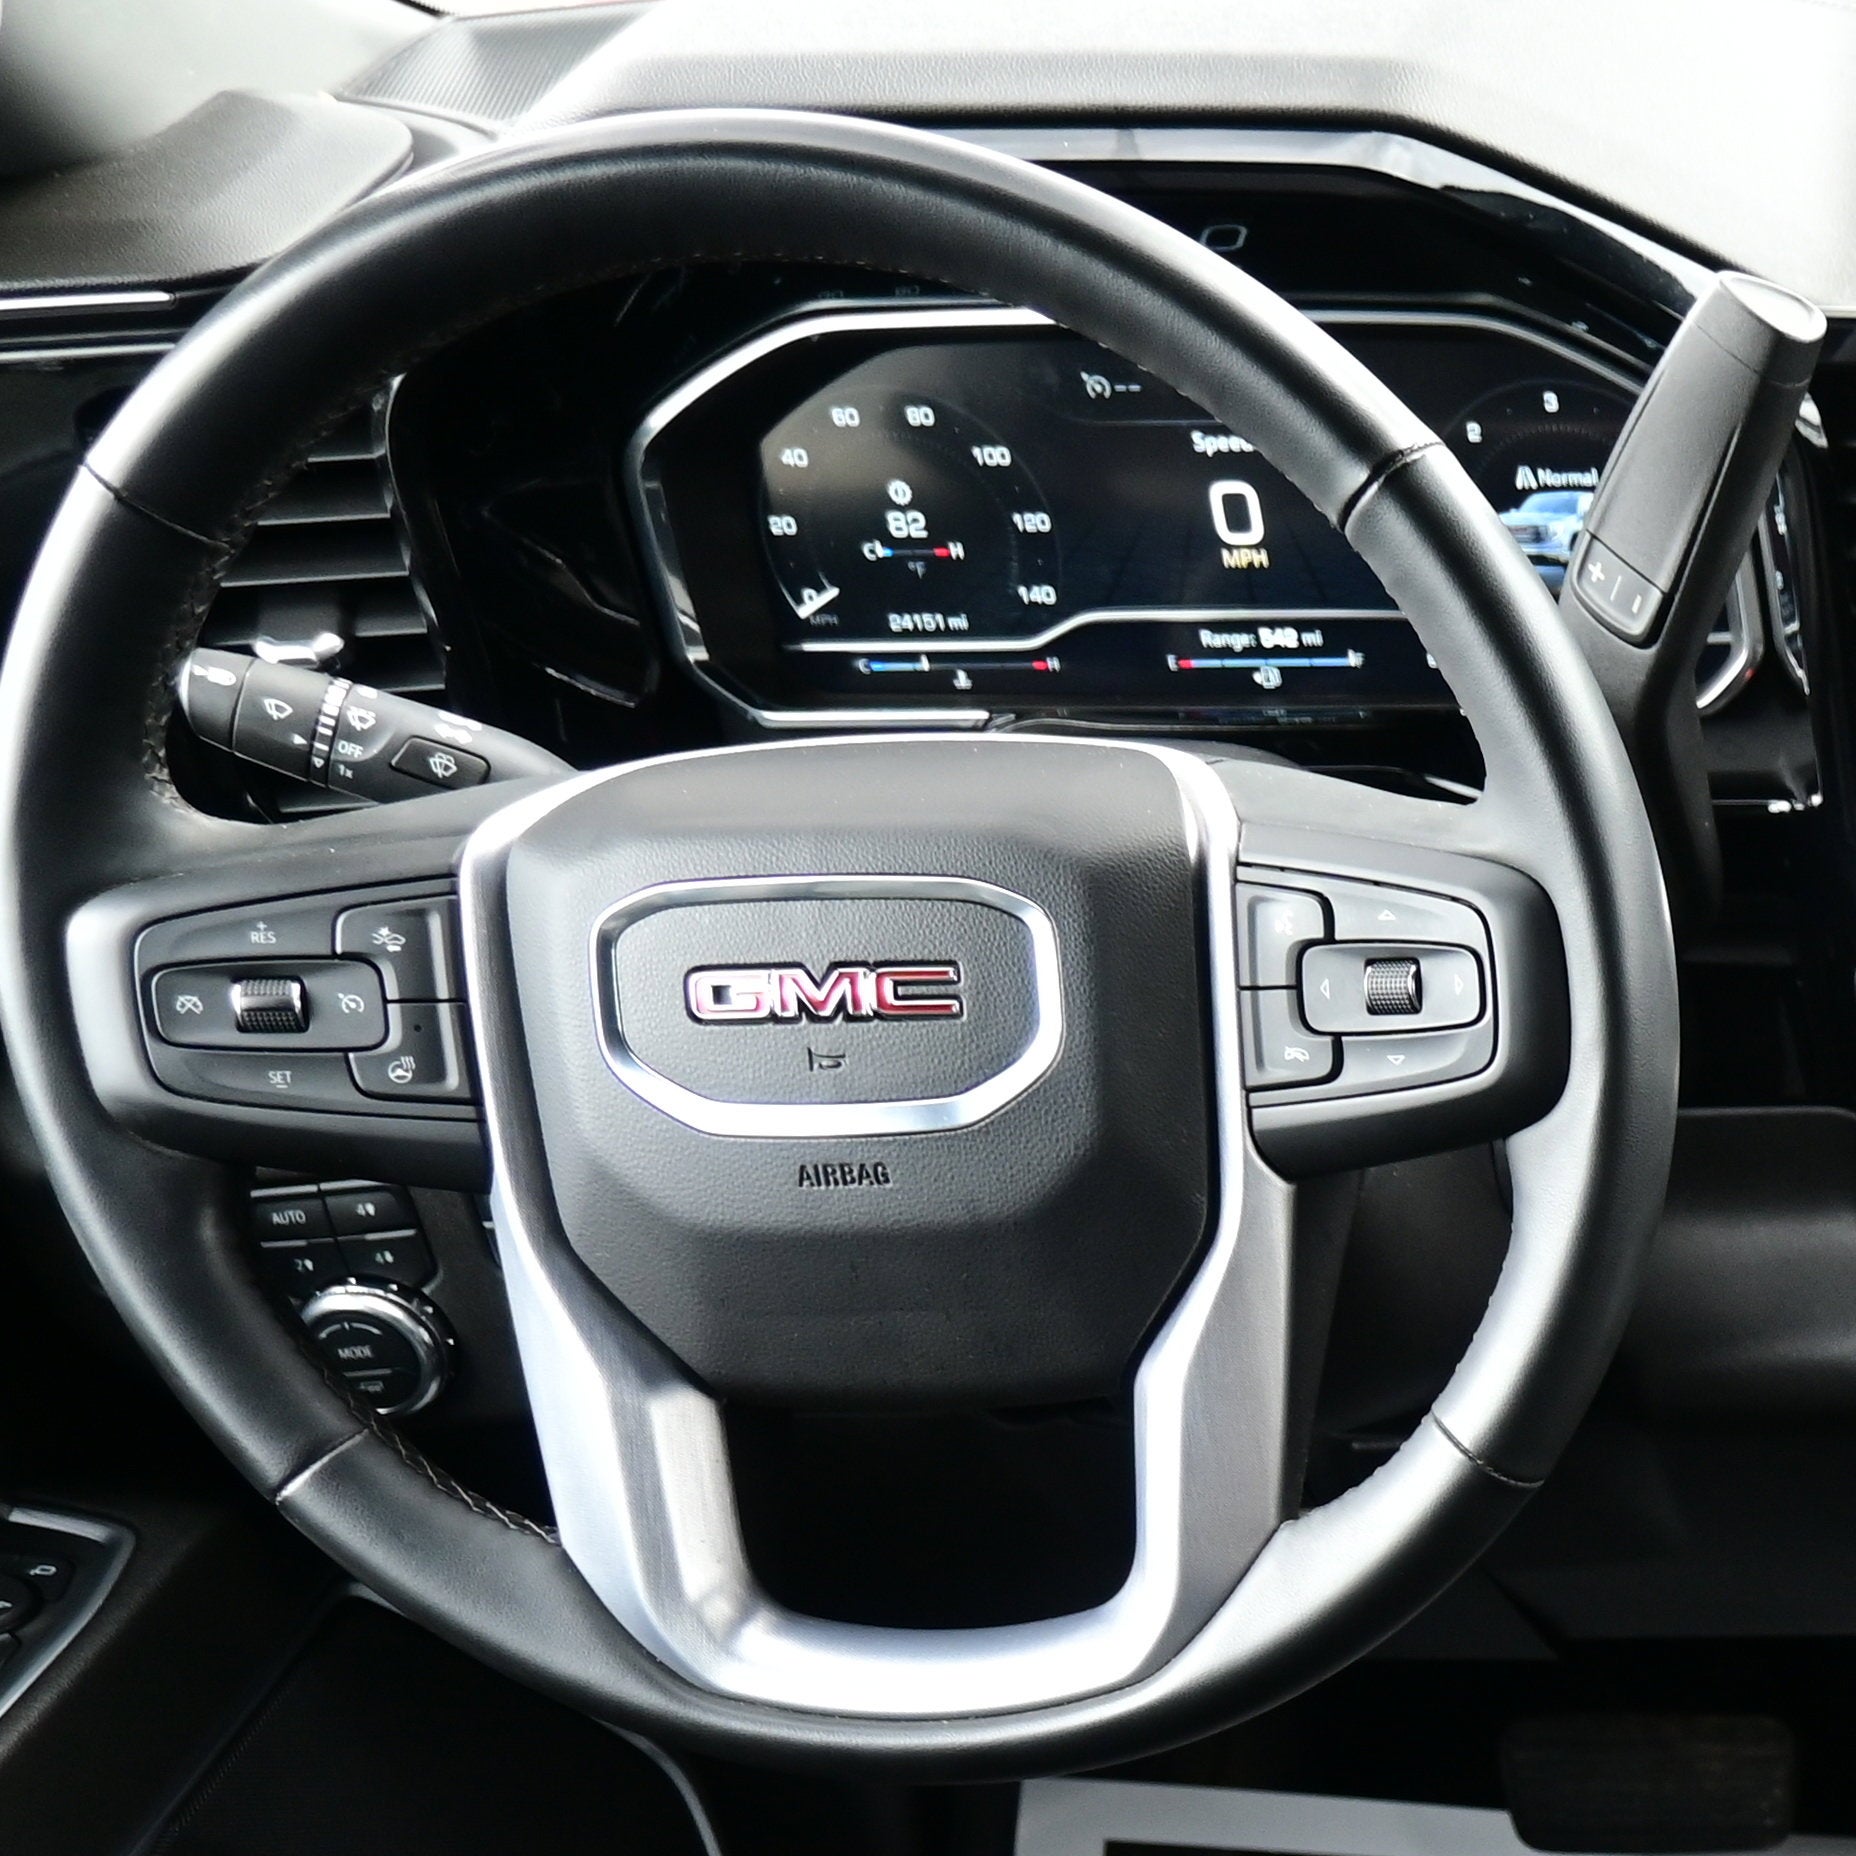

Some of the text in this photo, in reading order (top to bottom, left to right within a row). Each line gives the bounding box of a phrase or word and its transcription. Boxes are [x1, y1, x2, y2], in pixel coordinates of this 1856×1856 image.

[829, 406, 860, 427] 60
[1465, 421, 1483, 443] 2
[781, 448, 809, 468] 40
[971, 446, 1011, 467] 100
[1537, 467, 1599, 488] Normal
[1012, 512, 1051, 533] 120
[1208, 479, 1265, 546] 0
[768, 515, 798, 535] 20
[885, 510, 929, 538] 82
[1221, 548, 1269, 569] MPH
[1017, 585, 1056, 605] 140
[947, 613, 969, 631] mi
[1301, 629, 1324, 647] mi
[338, 741, 364, 758] OFF
[251, 931, 277, 944] RES
[686, 963, 964, 1023] GMC
[268, 1071, 292, 1083] SET
[798, 1161, 891, 1188] AIRBAG
[272, 1210, 306, 1225] AUTO
[337, 1345, 372, 1360] MODE
